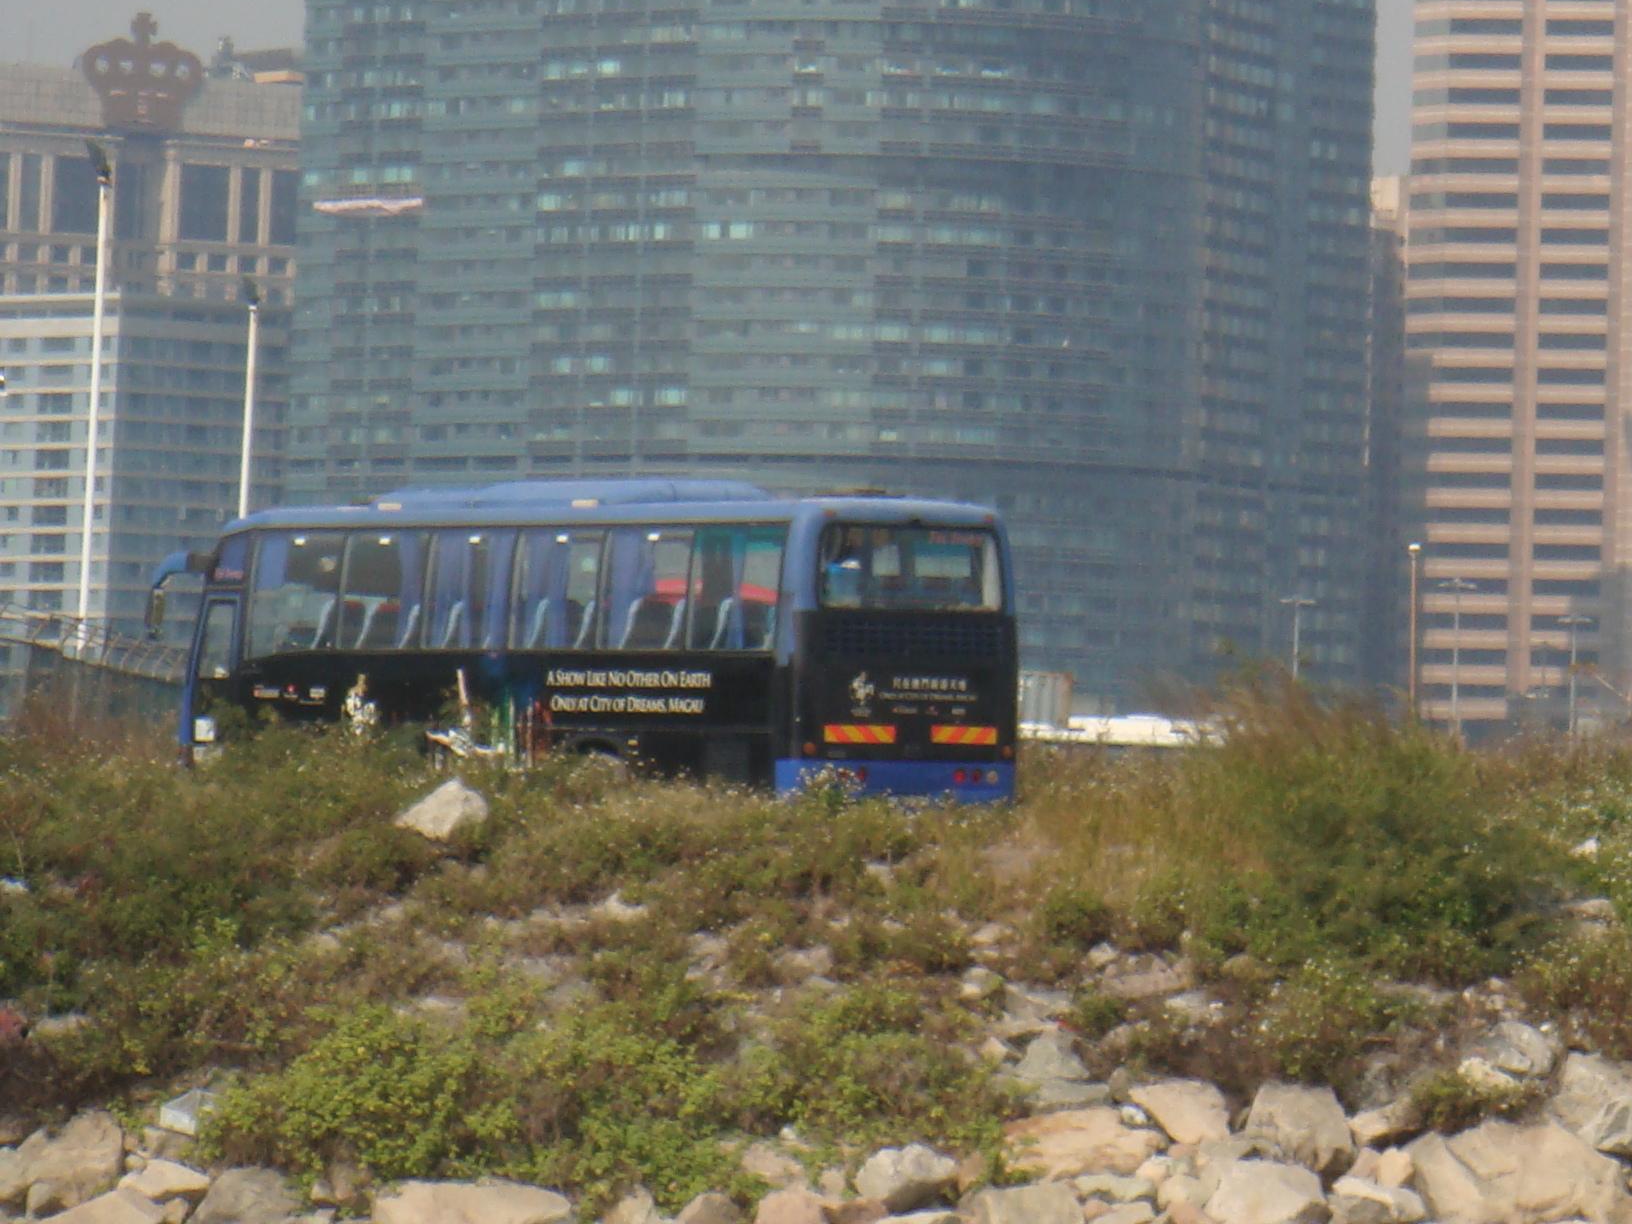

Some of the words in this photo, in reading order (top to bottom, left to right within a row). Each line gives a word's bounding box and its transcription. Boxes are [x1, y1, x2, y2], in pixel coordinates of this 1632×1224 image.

[557, 670, 586, 687] SHOW
[586, 670, 607, 687] LIKE
[608, 671, 626, 687] NO
[626, 670, 660, 688] OTHER
[660, 670, 679, 688] ON
[679, 671, 711, 688] EARTH
[590, 695, 613, 712] CITY
